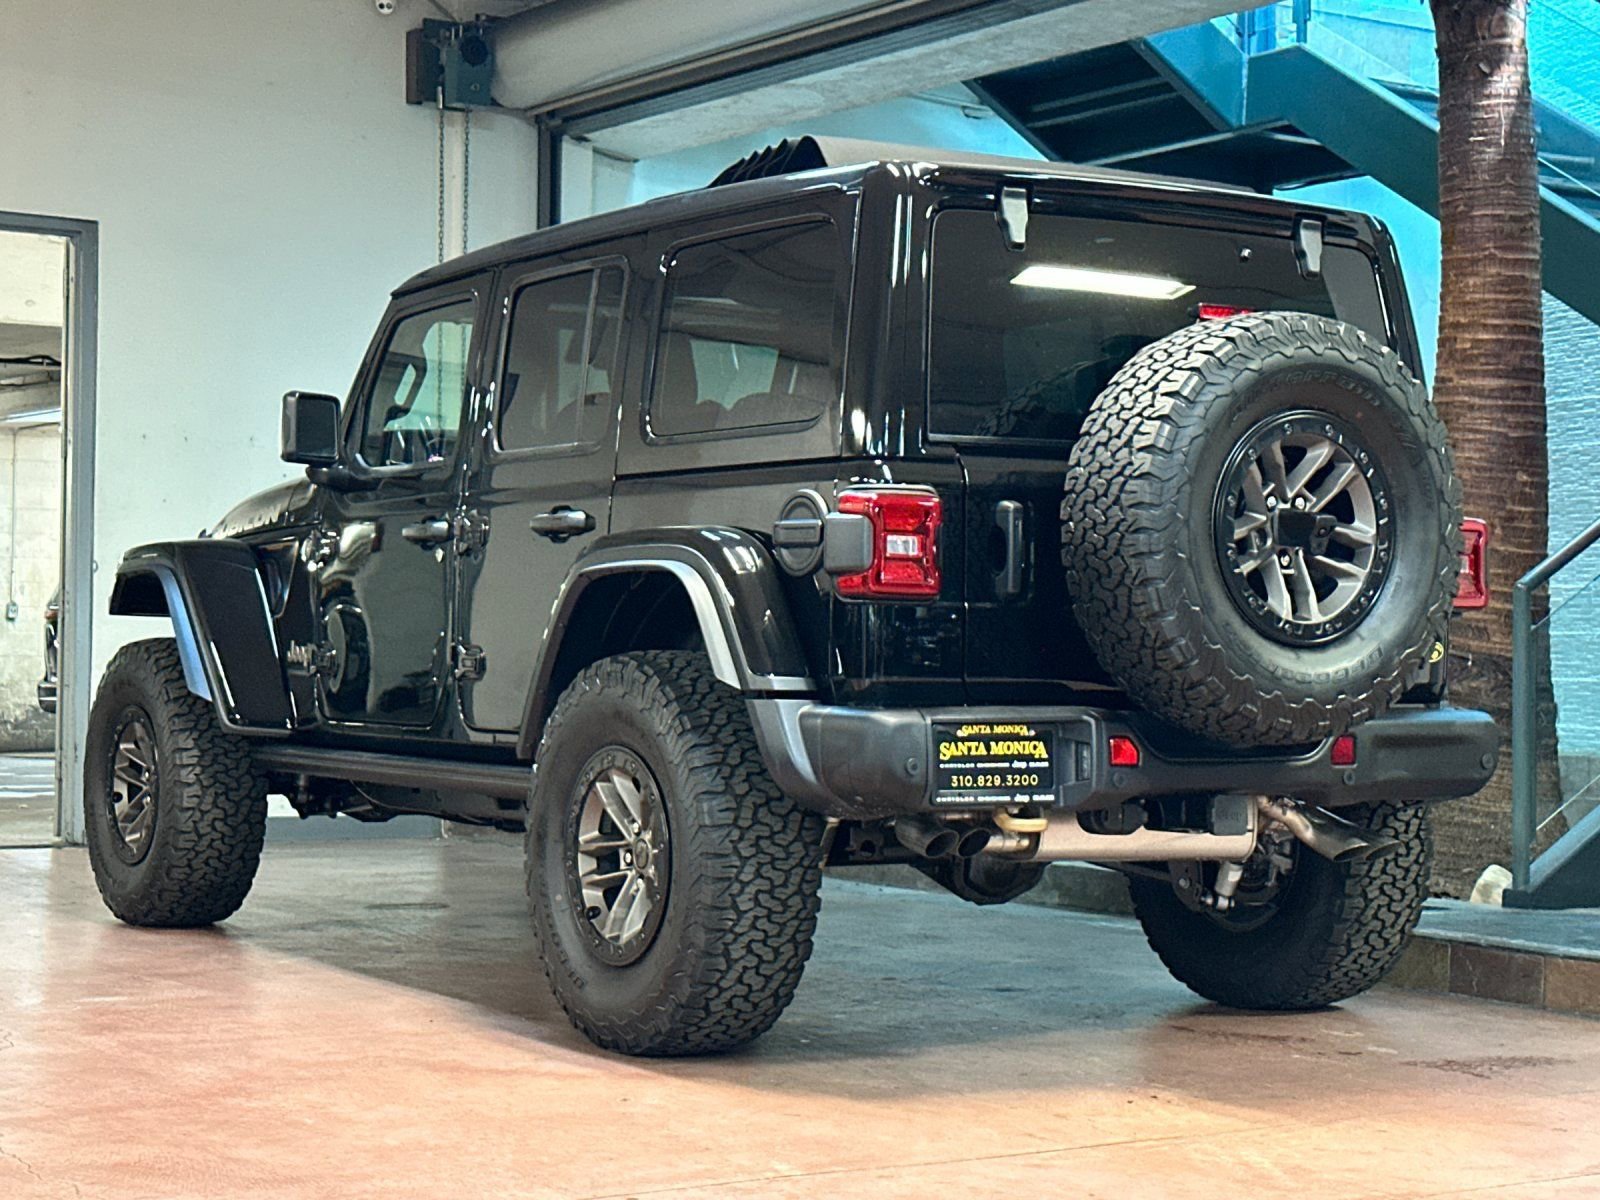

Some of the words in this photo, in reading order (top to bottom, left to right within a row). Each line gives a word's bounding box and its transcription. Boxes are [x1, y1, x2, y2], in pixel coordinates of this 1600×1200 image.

[961, 724, 991, 736] SANTA
[993, 724, 1029, 736] MONICA
[939, 741, 988, 760] SANTA
[989, 740, 1049, 759] MONICA
[950, 774, 1039, 787] 310.829.3200
